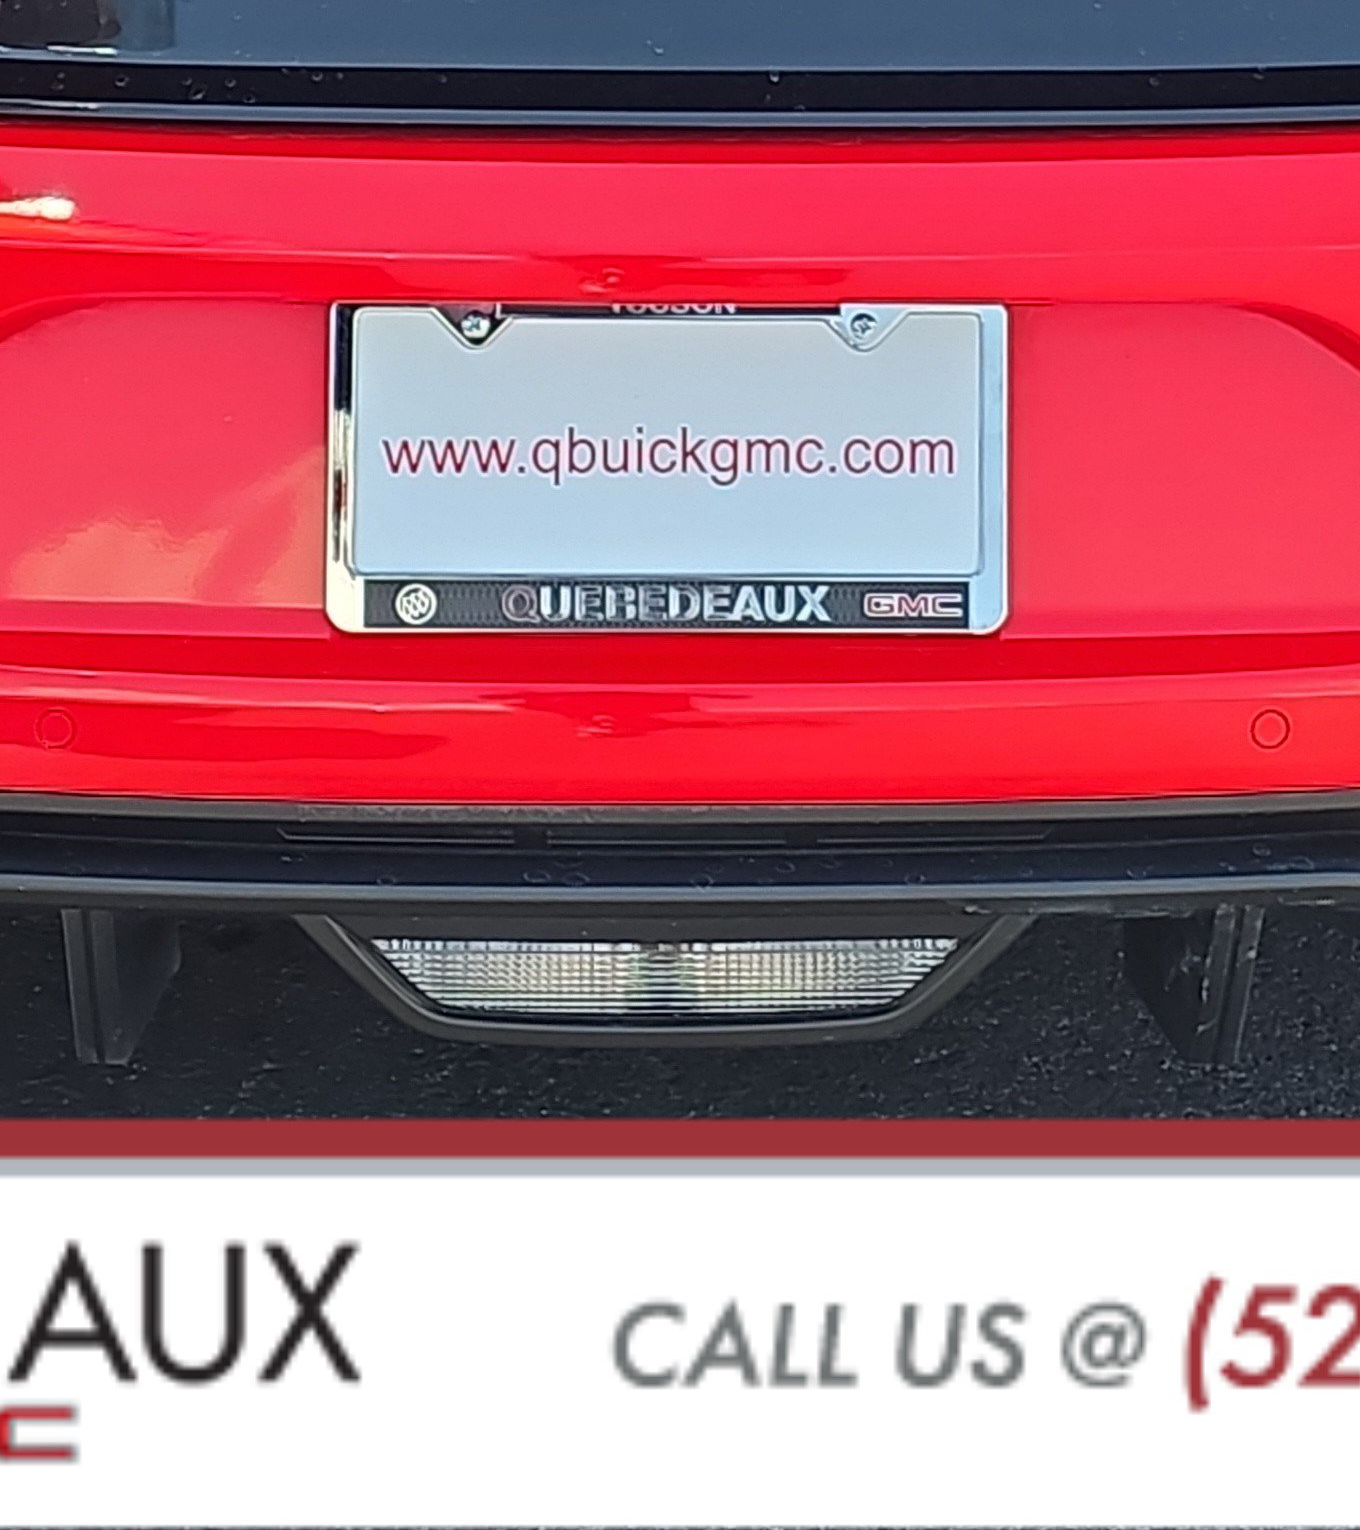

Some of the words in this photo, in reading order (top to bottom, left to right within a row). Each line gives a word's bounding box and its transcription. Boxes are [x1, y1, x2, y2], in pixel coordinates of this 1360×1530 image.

[381, 426, 956, 485] www.qbuickgmc.com
[500, 583, 833, 623] QUEBEDEAUX
[862, 592, 964, 618] GMC
